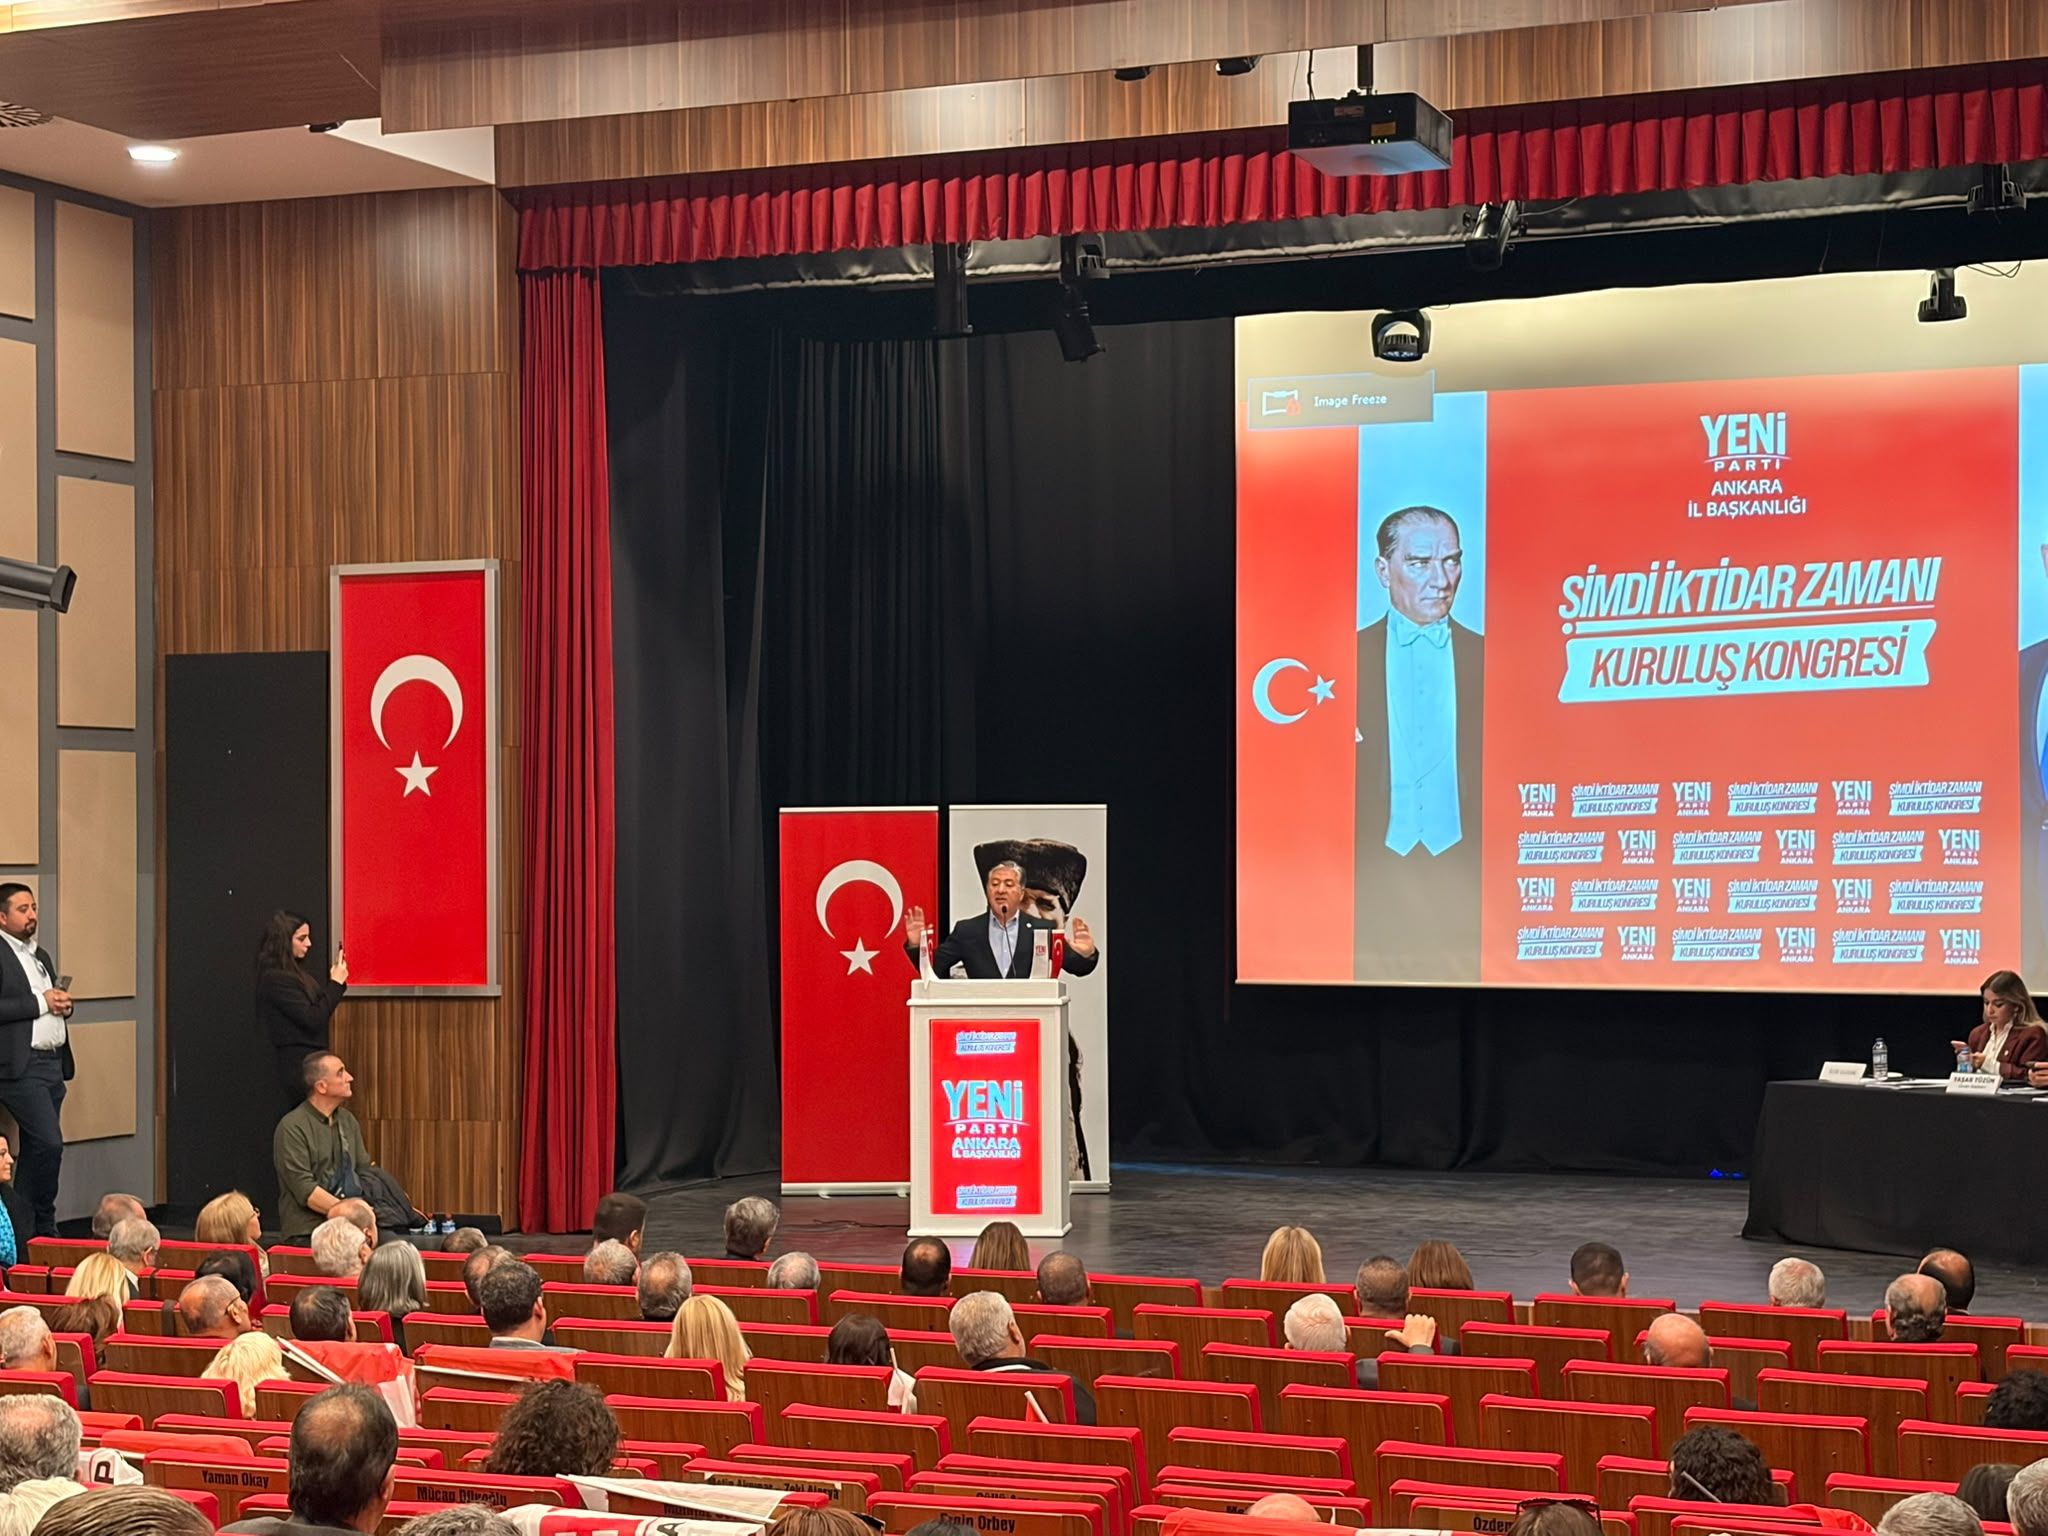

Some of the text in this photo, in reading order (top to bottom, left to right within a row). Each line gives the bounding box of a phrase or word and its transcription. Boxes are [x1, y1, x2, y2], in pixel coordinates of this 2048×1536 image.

[1314, 394, 1387, 408] Image Freeze
[1711, 479, 1783, 496] ANKARA
[1688, 496, 1806, 519] İL BAŞKANLIĞI
[1559, 556, 1942, 635] ŞİMDİ İKTİDAR ZAMANI
[1589, 625, 1909, 691] KURULUŞ KONGRESİ
[952, 1136, 1021, 1149] ANKARA
[202, 1470, 269, 1489] Yaman Okay
[978, 1514, 1015, 1533] Orbey
